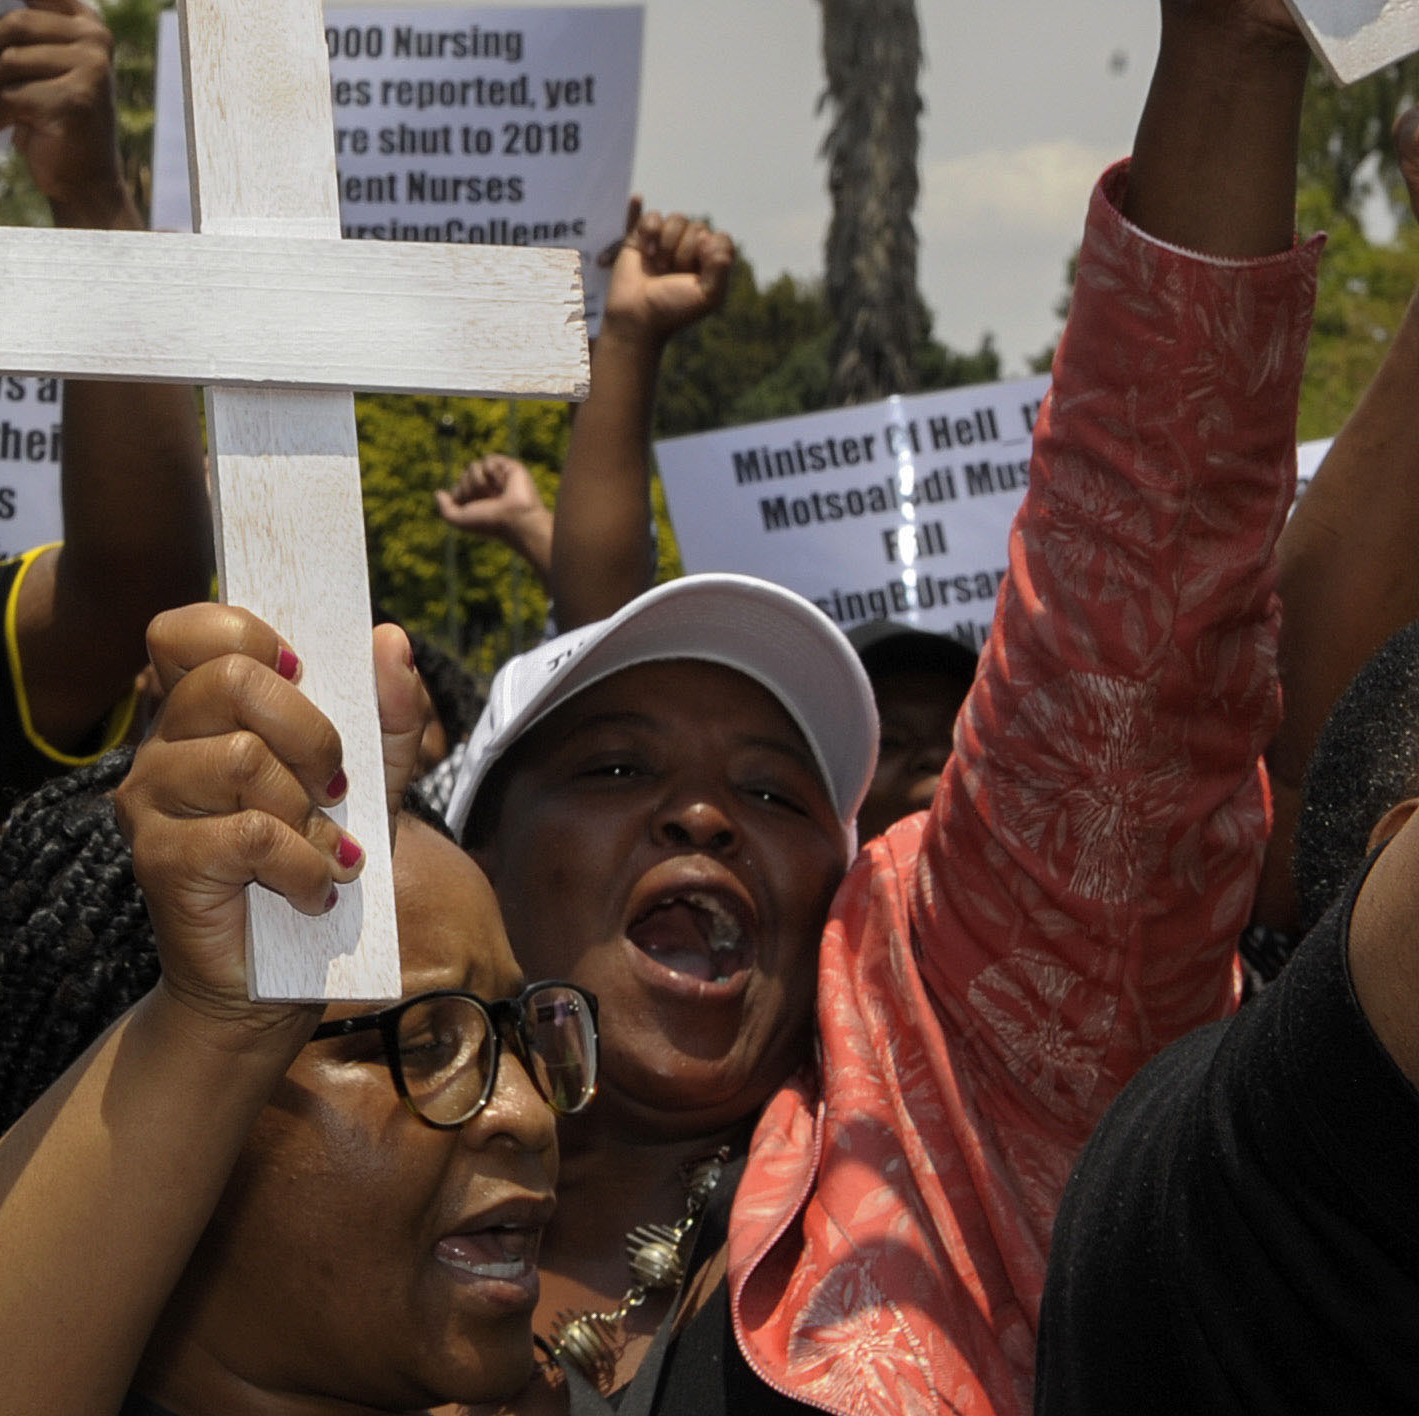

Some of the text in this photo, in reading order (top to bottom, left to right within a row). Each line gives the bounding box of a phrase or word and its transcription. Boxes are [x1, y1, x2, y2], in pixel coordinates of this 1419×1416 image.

[393, 25, 523, 63] Nursing
[380, 73, 535, 111] reported,
[544, 73, 595, 108] yet
[379, 123, 452, 155] shut
[463, 124, 493, 154] to
[502, 121, 581, 155] 2018
[407, 170, 524, 203] Nurses
[732, 435, 875, 484] Minister
[883, 521, 948, 563] Fll
